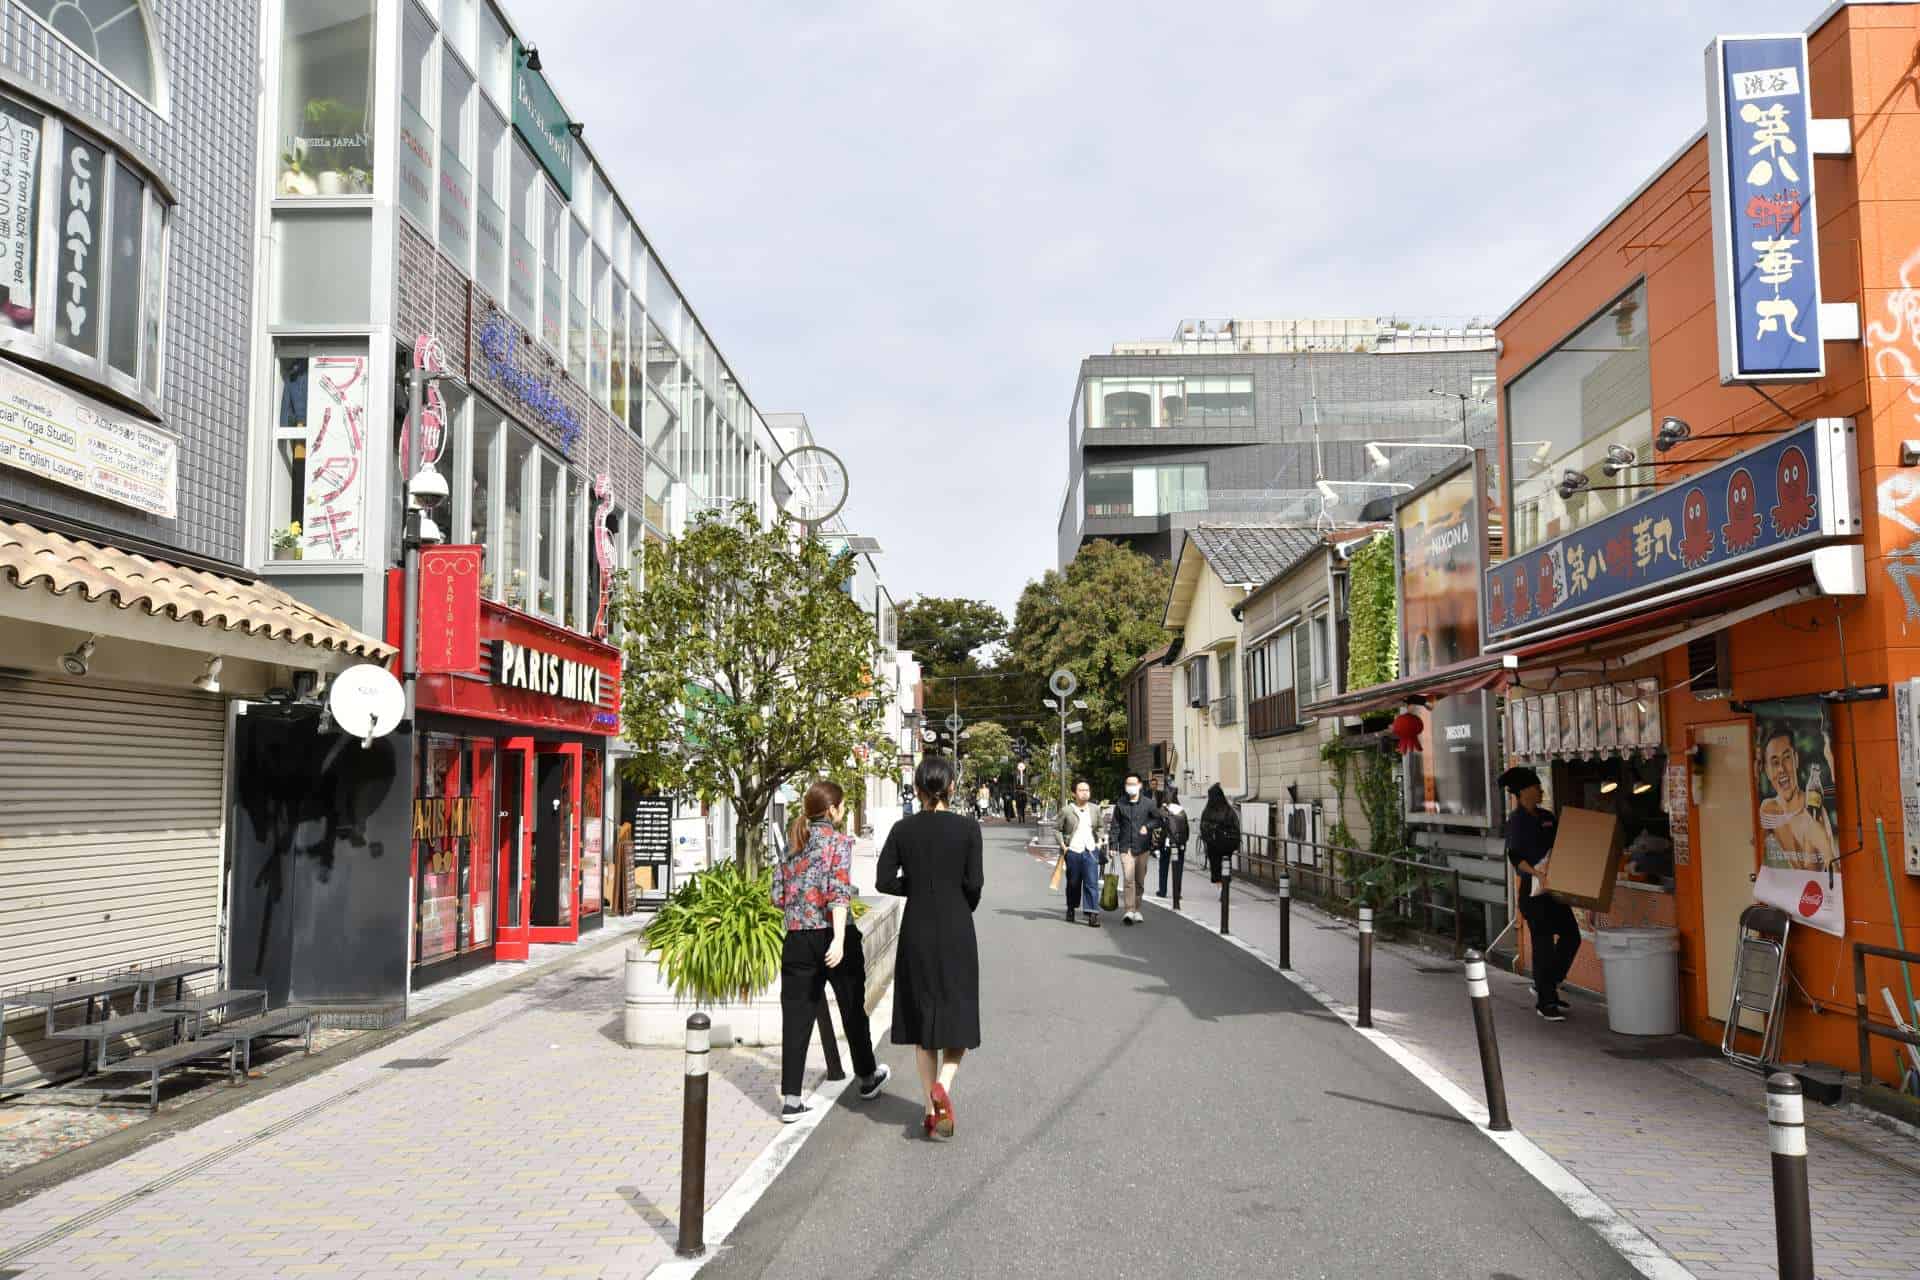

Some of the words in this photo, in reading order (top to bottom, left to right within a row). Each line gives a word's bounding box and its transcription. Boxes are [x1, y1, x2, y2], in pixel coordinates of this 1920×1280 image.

[1743, 71, 1788, 95] 渋谷
[19, 128, 34, 165] Enter
[17, 170, 31, 205] from
[15, 207, 29, 241] back
[14, 243, 25, 284] street
[22, 416, 44, 435] Yoga
[47, 425, 74, 446] Studio
[19, 447, 50, 469] English
[53, 463, 84, 481] Lounge
[1431, 525, 1461, 558] NIXON
[446, 575, 455, 622] PARIS
[501, 640, 560, 696] PARIS
[562, 658, 600, 705] MIKI
